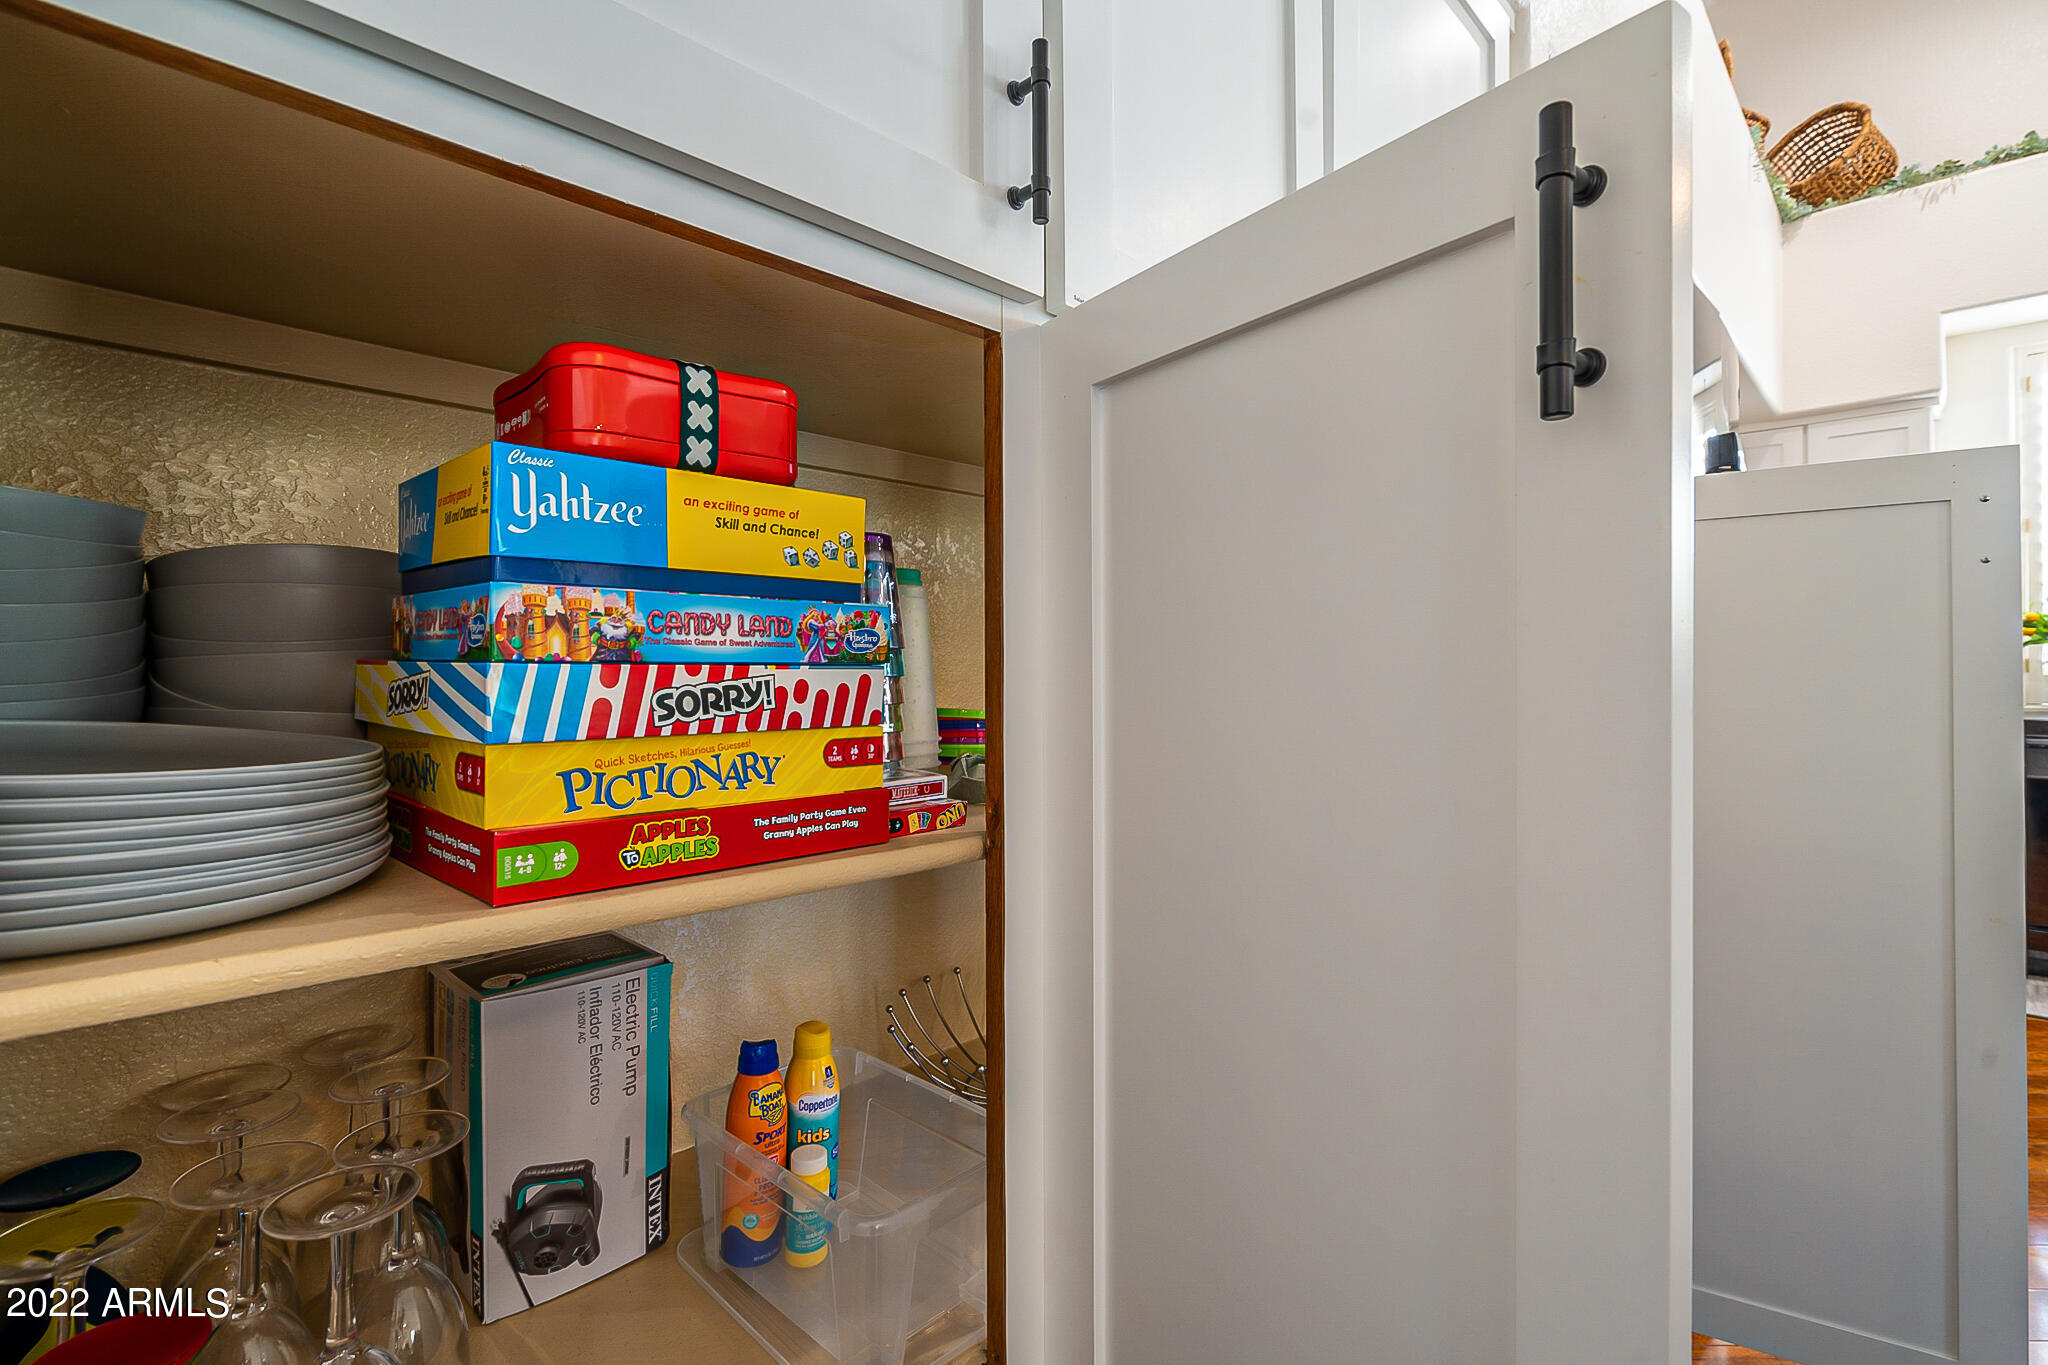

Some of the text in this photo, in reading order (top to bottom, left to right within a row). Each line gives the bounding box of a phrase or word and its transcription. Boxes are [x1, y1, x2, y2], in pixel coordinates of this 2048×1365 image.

[507, 448, 555, 468] Classic
[507, 468, 643, 534] Yahtzee
[683, 497, 800, 520] an exciting game of
[715, 516, 820, 540] Skill and Chance!
[647, 609, 793, 638] CANDY LAND
[644, 636, 796, 649] The Classic Game of Sweet Adventures!
[387, 672, 430, 716] SORRY!
[653, 677, 774, 724] SORRY!
[594, 738, 752, 769] Quick Sketches, Hilarious Guesses!
[833, 746, 838, 755] 2
[556, 752, 782, 813] PICTIONARY
[632, 816, 709, 845] APPLES
[753, 806, 867, 827] The Family Party Game Even
[763, 819, 859, 840] Granny Apples Can Play
[641, 837, 718, 866] APPLES
[577, 990, 586, 1045] 110-120V AC
[611, 982, 622, 1051] 110-120V AC
[650, 1006, 659, 1033] FILL
[589, 986, 603, 1106] Inflador Eléctrico
[622, 977, 640, 1097] Electric Pump
[759, 1098, 783, 1118] BOAT
[798, 1094, 838, 1113] Coppertone
[753, 1123, 786, 1146] SPORT
[797, 1127, 831, 1144] kids
[648, 1174, 662, 1245] INTEX
[472, 1236, 481, 1312] INTEX
